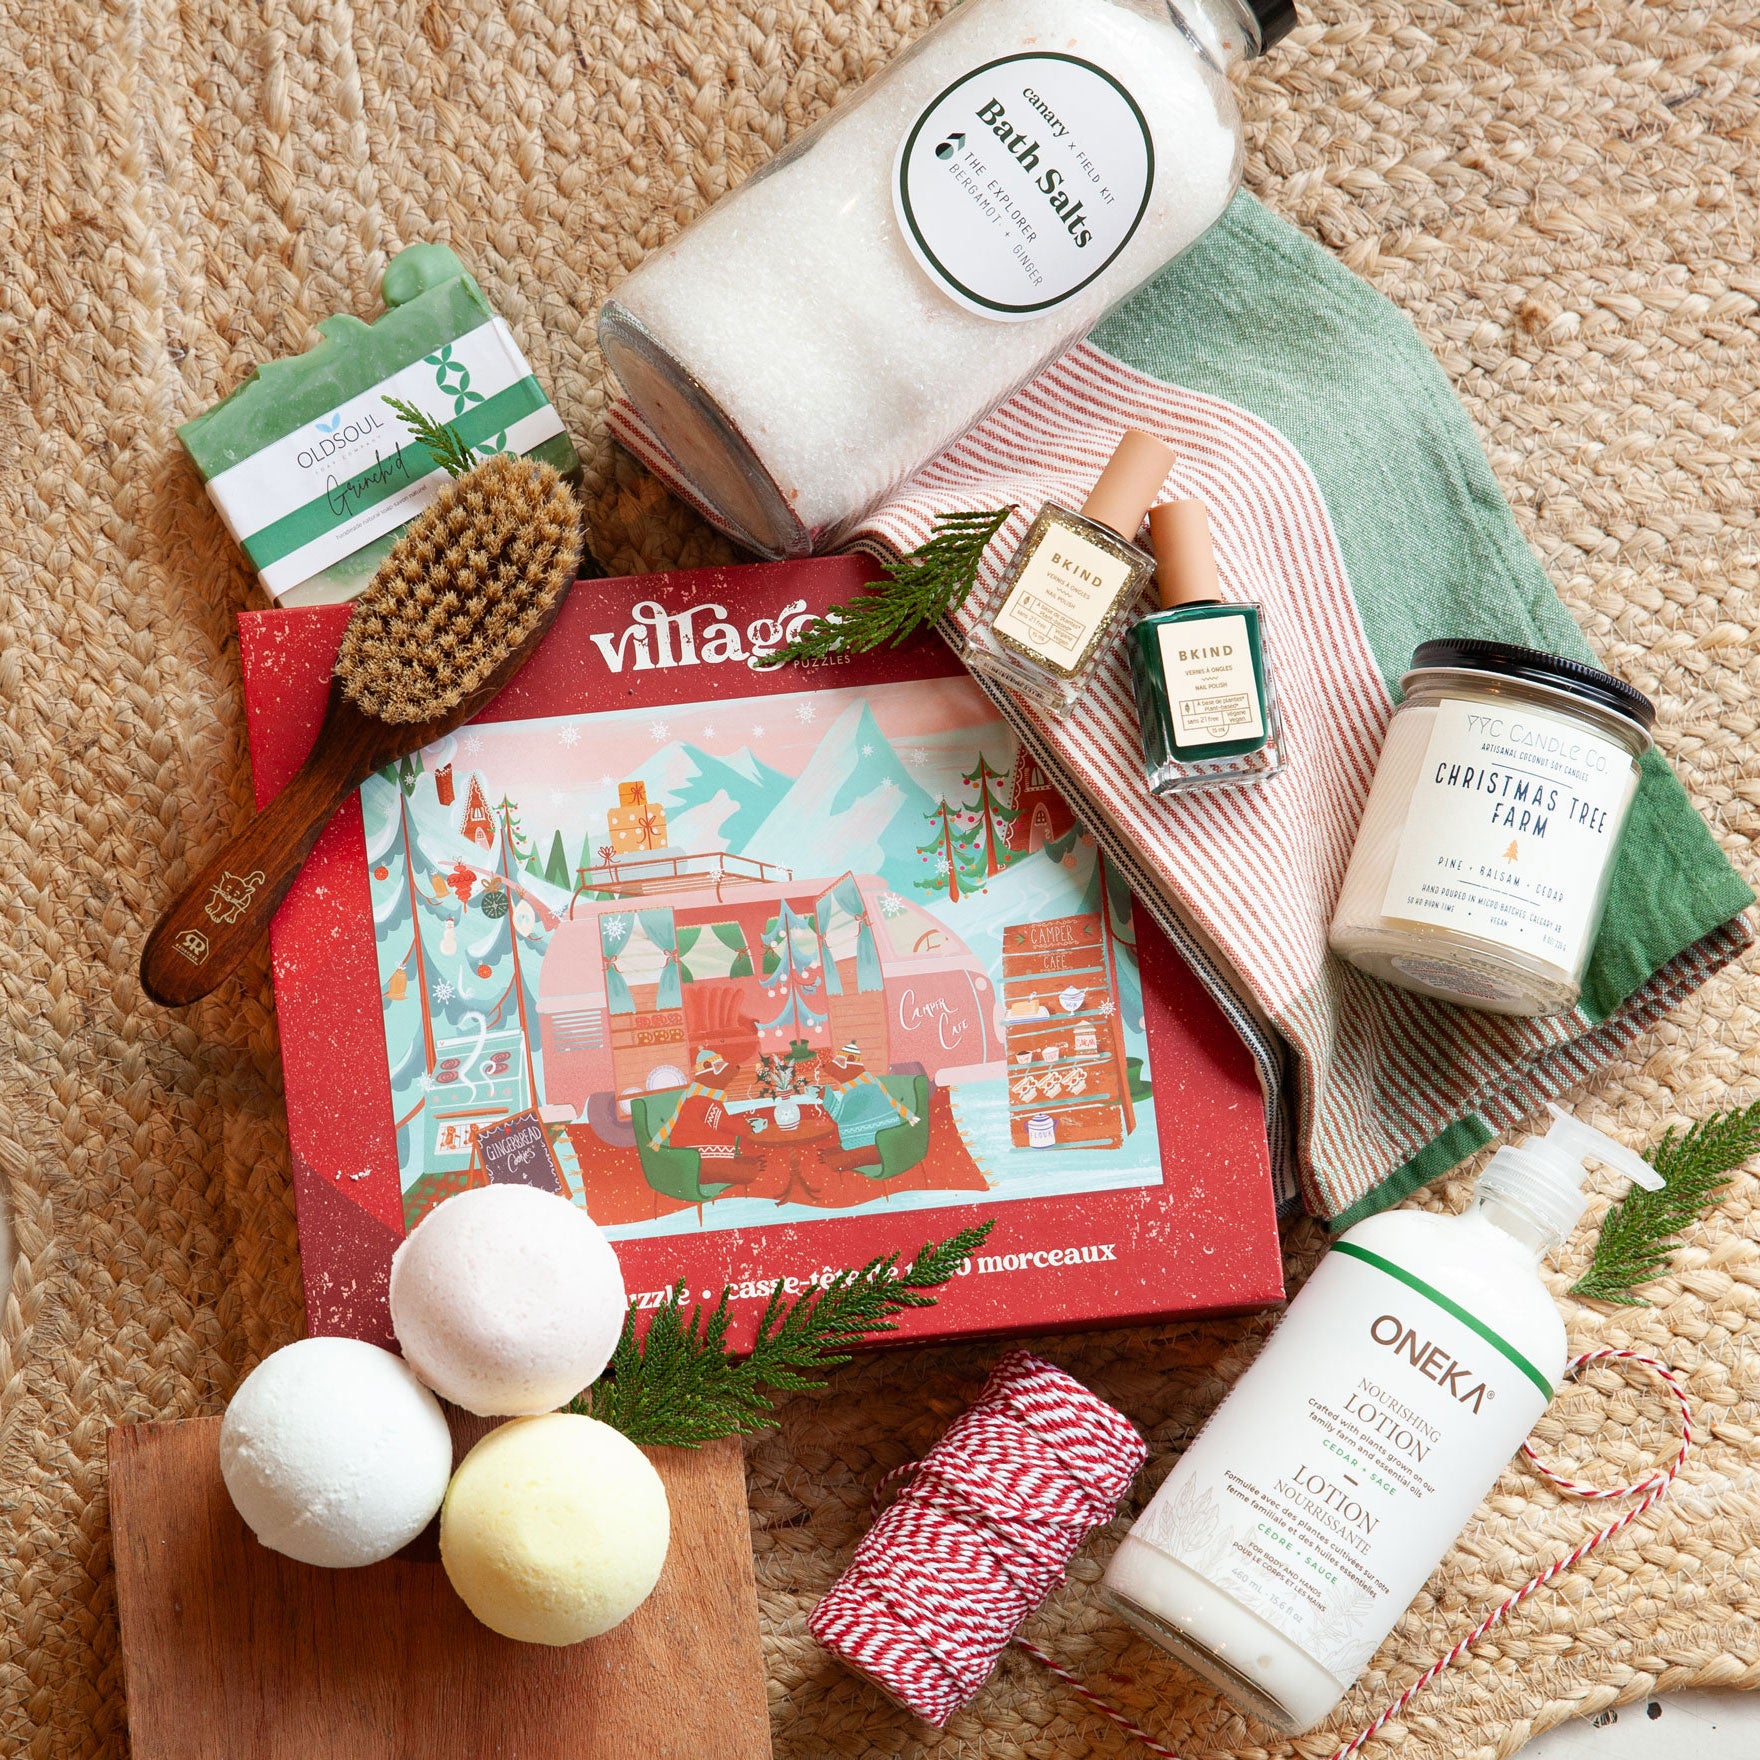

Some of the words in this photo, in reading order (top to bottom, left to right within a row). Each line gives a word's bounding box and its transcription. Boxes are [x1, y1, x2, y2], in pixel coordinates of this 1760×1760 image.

[975, 97, 1040, 174] Bath
[1035, 169, 1093, 248] Salts
[1022, 87, 1069, 138] canary
[1075, 152, 1100, 184] FIELD
[1099, 187, 1115, 205] KIT
[949, 164, 1001, 225] BERGAMOT
[1012, 244, 1043, 286] GINGER
[964, 152, 987, 176] THE
[988, 180, 1037, 243] EXPLORER
[297, 414, 384, 469] OLDSOUL
[1051, 552, 1103, 587] BKIND
[793, 654, 851, 669] PUZZLES
[1179, 645, 1233, 661] BKIND
[1211, 665, 1233, 673] ONGLES
[1208, 682, 1228, 690] POLISH
[1467, 714, 1503, 738] YYC
[1481, 743, 1518, 759] ARTISANAL
[1520, 751, 1549, 767] COCONUT
[1550, 761, 1562, 771] SOY
[1563, 765, 1589, 782] CANDLES
[1435, 762, 1558, 812] CHRISTMAS
[1569, 797, 1607, 833] TREE
[1491, 802, 1548, 838] FARM
[1438, 856, 1463, 871] PINE
[1480, 865, 1521, 887] BALSAM
[1535, 883, 1564, 902] CEDAR
[1441, 888, 1467, 901] POURED
[1468, 894, 1476, 903] IN
[1031, 924, 1074, 944] CAMPER
[1441, 902, 1455, 913] TIME
[1044, 954, 1067, 969] CAFE
[486, 1126, 542, 1161] GINGERBREAD
[977, 1244, 1117, 1274] morceaux
[1343, 1393, 1431, 1463] LOTION
[1358, 1377, 1442, 1444] NOURISHING
[1308, 1398, 1339, 1421] Crafted
[1340, 1417, 1360, 1436] with
[1360, 1431, 1387, 1455] plants
[1387, 1454, 1413, 1475] grown
[1413, 1473, 1423, 1484] on
[1423, 1480, 1435, 1494] our
[1309, 1411, 1335, 1433] family
[1336, 1430, 1356, 1447] farm
[1357, 1444, 1375, 1460] and
[1375, 1458, 1410, 1488] essential
[1409, 1484, 1423, 1498] oils
[1322, 1439, 1358, 1467] CEDAR
[1369, 1473, 1396, 1496] SAGE
[1273, 1479, 1372, 1556] NOURRISSANTE
[1292, 1464, 1380, 1535] LOTION
[1224, 1470, 1260, 1496] Formulée
[1261, 1493, 1281, 1510] avec
[1282, 1507, 1297, 1521] des
[1297, 1519, 1329, 1545] plantes
[1330, 1542, 1363, 1572] cultivées
[1363, 1569, 1375, 1581] sur
[1374, 1577, 1390, 1595] notre
[1226, 1484, 1249, 1503] ferme
[1250, 1500, 1287, 1528] familiale
[1288, 1525, 1298, 1536] et
[1298, 1533, 1313, 1547] des
[1314, 1544, 1339, 1567] huiles
[1340, 1564, 1377, 1598] essentielles
[1231, 1567, 1249, 1583] 460
[1269, 1593, 1286, 1610] 15.6
[1293, 1612, 1304, 1623] oz
[1232, 1541, 1253, 1558] POUR
[1252, 1554, 1262, 1564] LE
[1262, 1561, 1286, 1581] CORPS
[1285, 1578, 1294, 1588] ET
[1293, 1584, 1307, 1597] LES
[1307, 1595, 1327, 1613] MAINS
[1248, 1541, 1264, 1555] FOR
[1264, 1552, 1285, 1569] BODY
[1283, 1566, 1299, 1580] AND
[1299, 1578, 1322, 1598] HANDS
[1304, 1556, 1338, 1585] SAUGE
